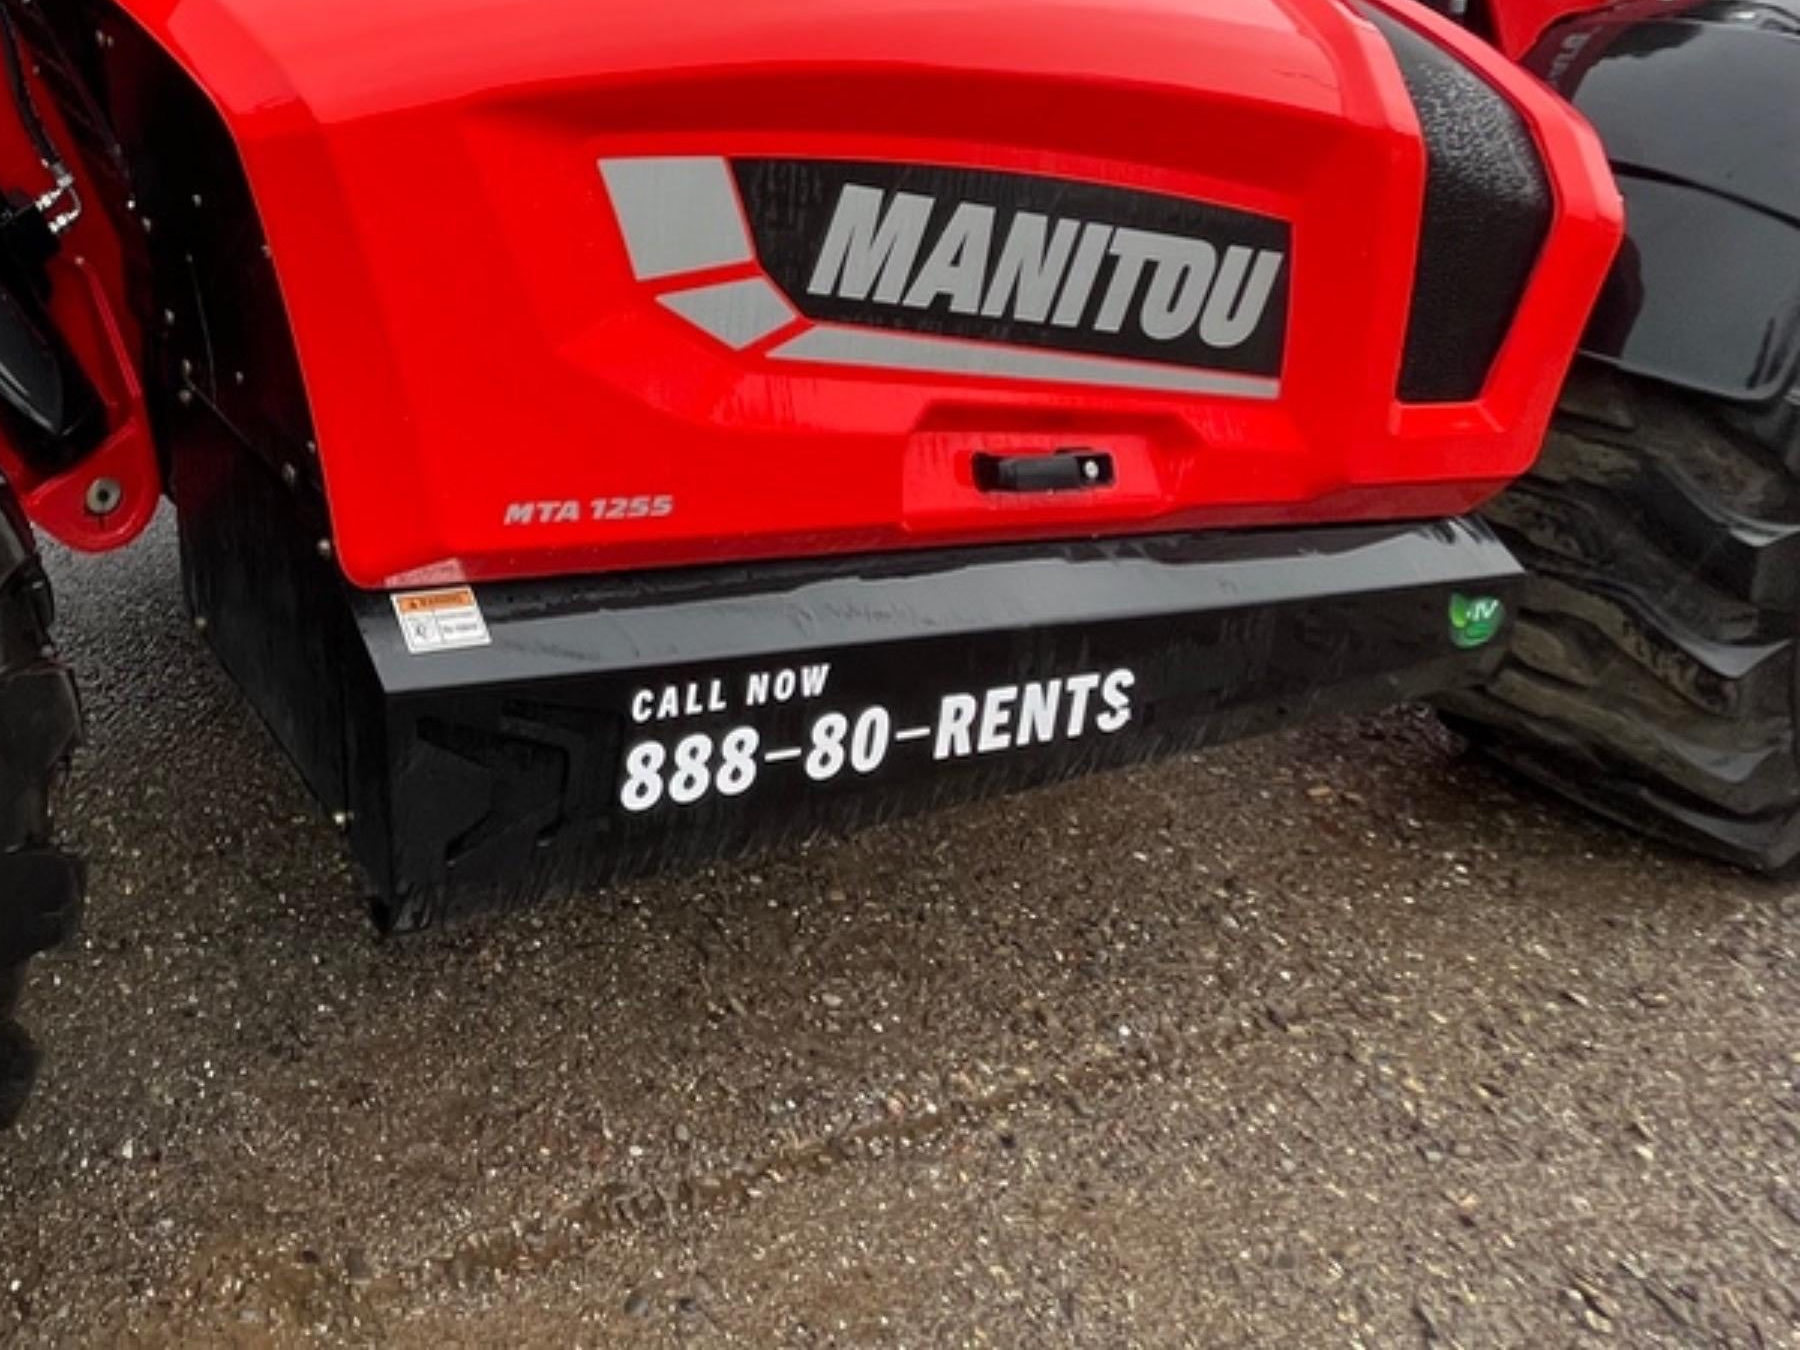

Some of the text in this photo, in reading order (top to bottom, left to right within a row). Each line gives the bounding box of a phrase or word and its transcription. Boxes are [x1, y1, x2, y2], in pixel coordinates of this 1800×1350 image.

[807, 183, 1283, 348] MANITOU
[503, 494, 674, 526] MTA 1255
[620, 668, 1137, 811] 888-80-RENTS
[631, 662, 832, 723] CALL NOW
